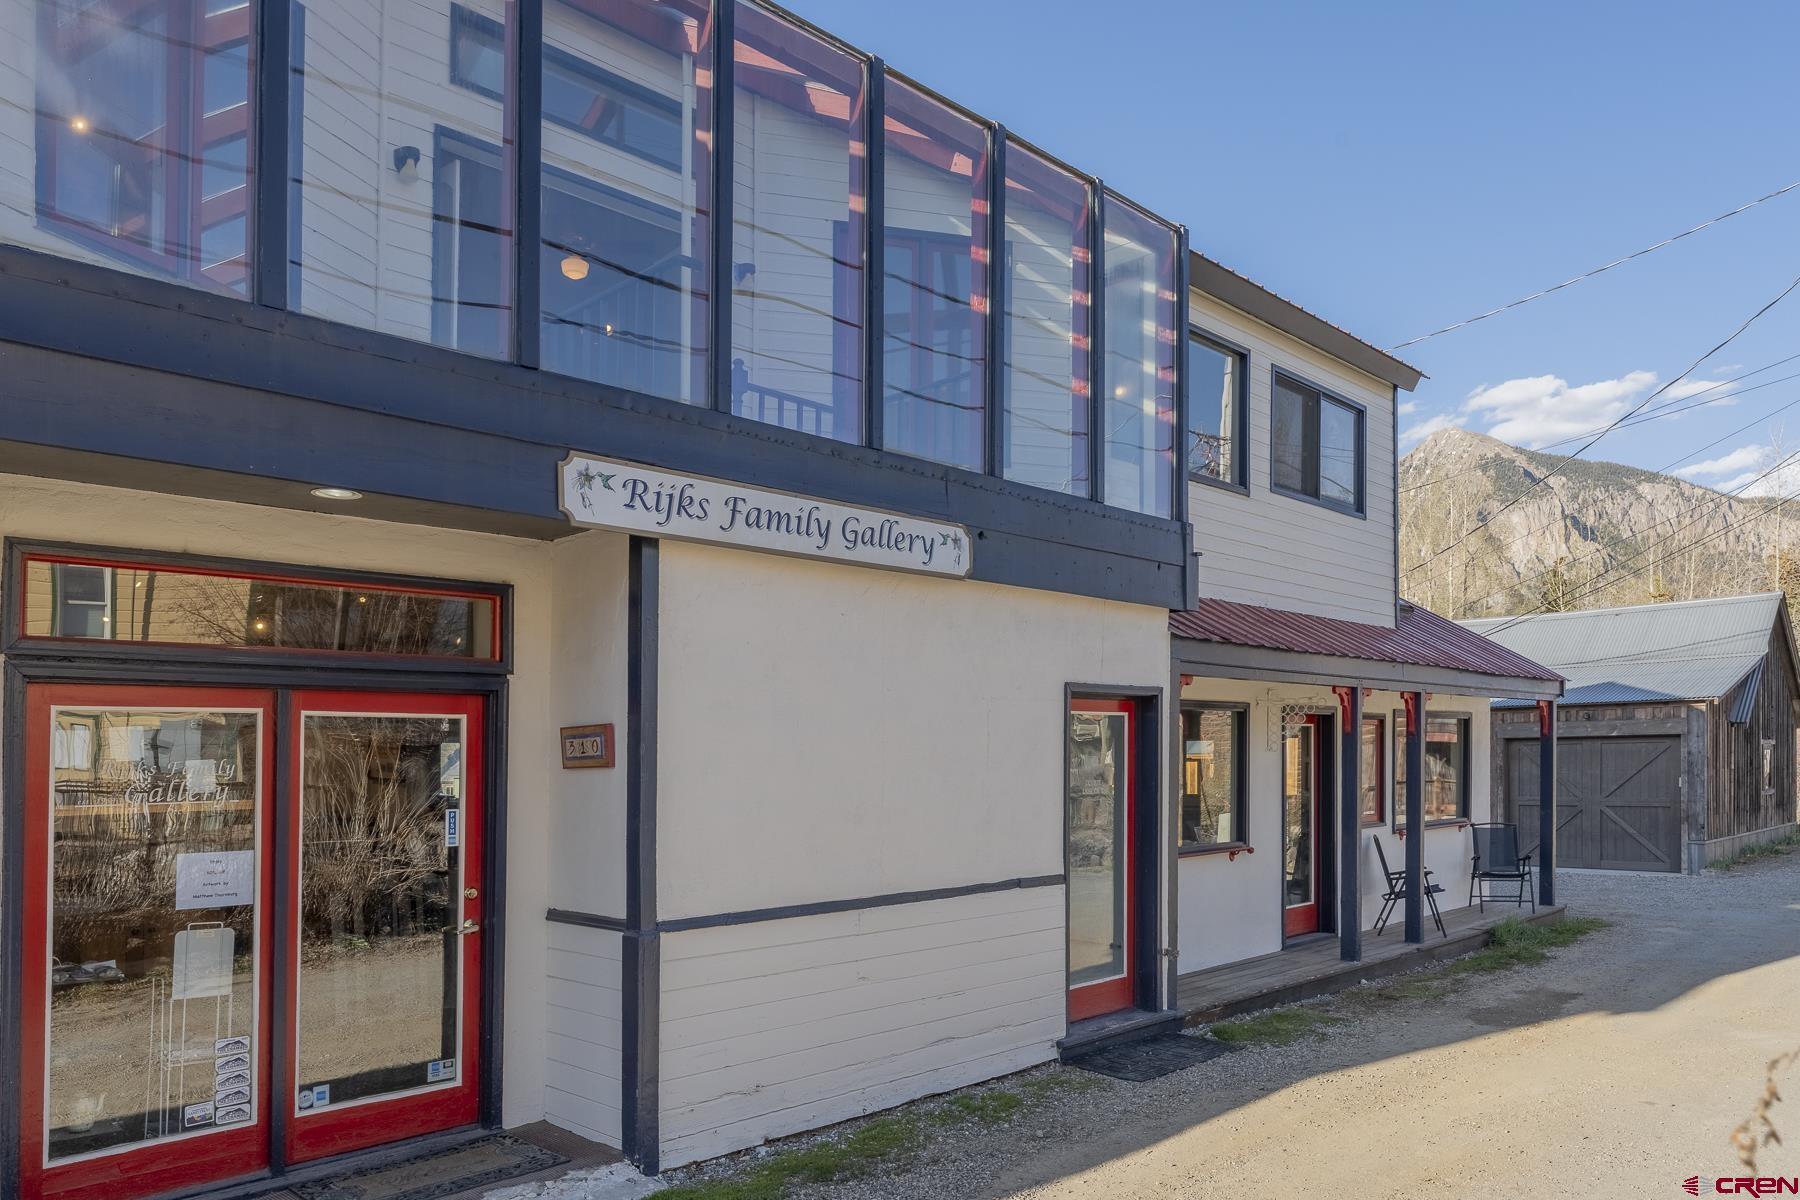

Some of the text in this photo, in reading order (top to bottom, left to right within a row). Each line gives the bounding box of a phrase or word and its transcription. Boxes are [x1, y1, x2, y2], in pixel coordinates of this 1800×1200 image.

[622, 477, 936, 566] Rijks Family Gallery
[567, 739, 599, 755] 310
[125, 779, 230, 808] Gallery
